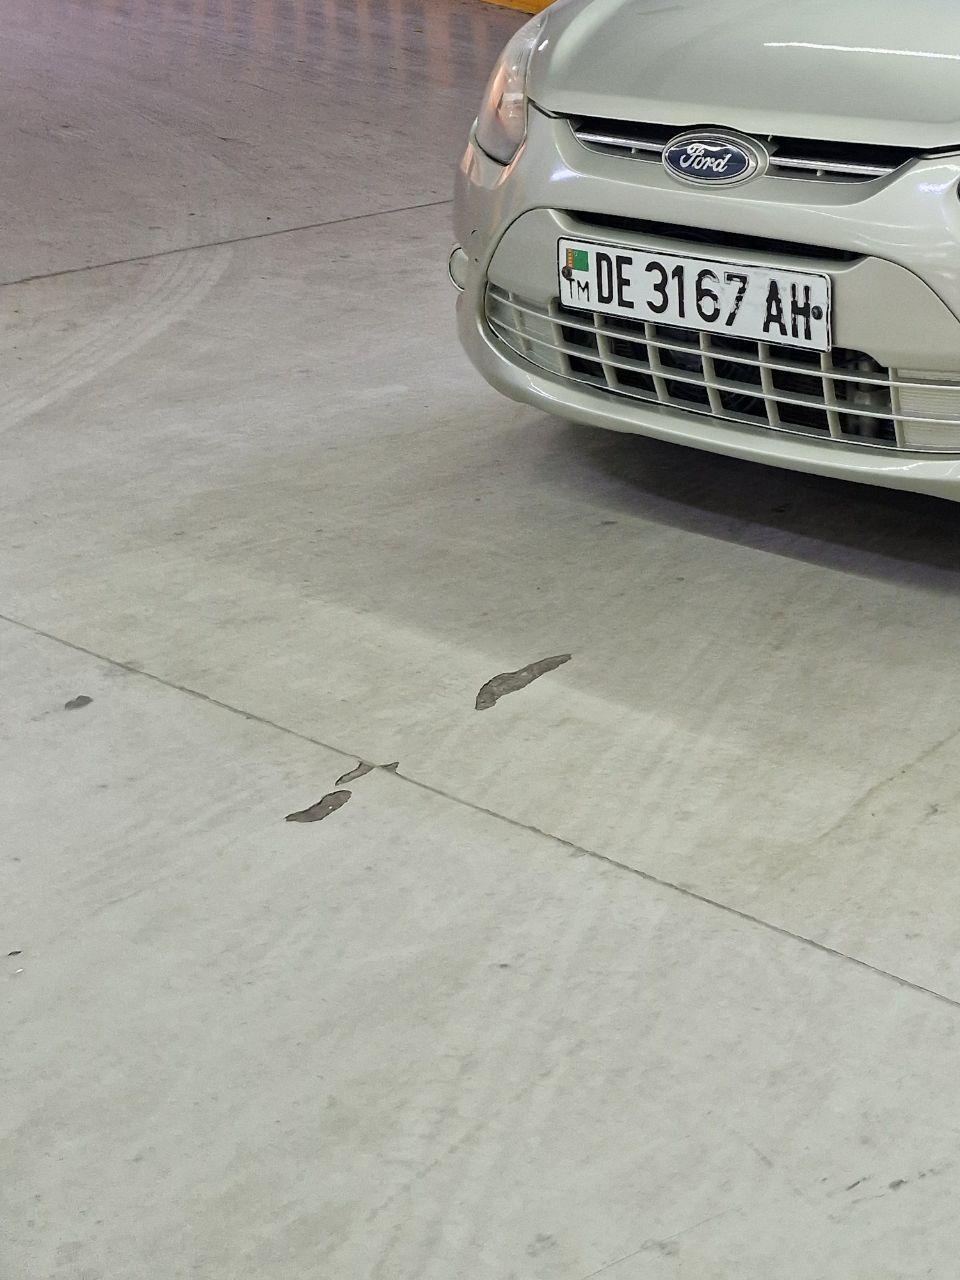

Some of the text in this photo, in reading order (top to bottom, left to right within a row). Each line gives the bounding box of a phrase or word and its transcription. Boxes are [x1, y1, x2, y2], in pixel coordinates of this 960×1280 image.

[679, 142, 731, 173] Ford
[566, 278, 590, 302] TM
[595, 252, 813, 341] DE 3167 AH
